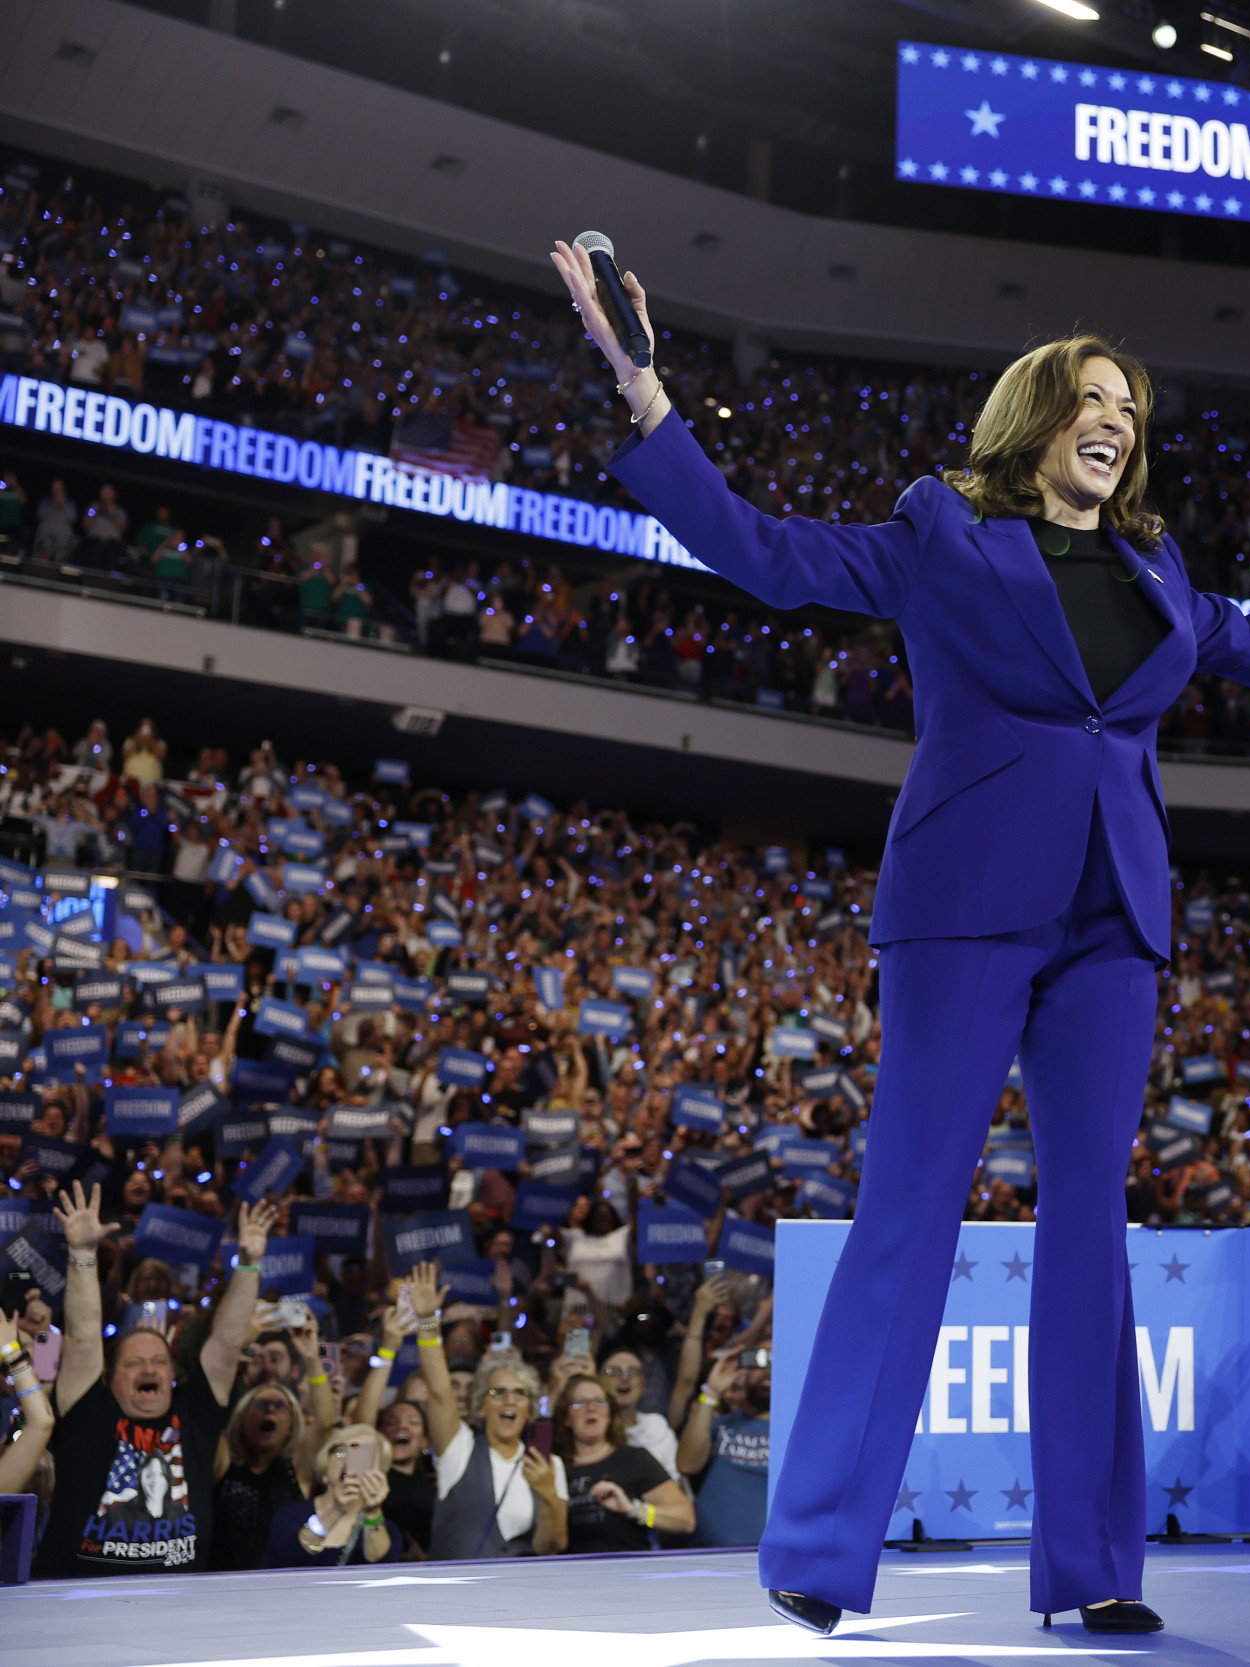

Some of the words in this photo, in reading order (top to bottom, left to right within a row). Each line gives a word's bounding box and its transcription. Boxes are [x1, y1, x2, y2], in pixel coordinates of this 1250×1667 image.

[15, 377, 194, 462] FREEDOM
[194, 417, 356, 495] FREEDOM
[354, 452, 507, 526] FREEDOM
[507, 486, 647, 558] FREEDOM
[76, 982, 120, 999] FREEDOM
[156, 984, 204, 1004] FREEDOM
[53, 1036, 101, 1057] FREEDOM
[113, 1100, 172, 1118] FREEDOM
[333, 1111, 390, 1128] FREEDOM
[223, 1122, 266, 1142] FREEDOM
[528, 1117, 575, 1133] FREEDOM
[465, 1135, 519, 1154] FREEDOM
[145, 1217, 213, 1249] FREEDOM
[298, 1215, 361, 1238] FREEDOM
[648, 1223, 705, 1245] FREEDOM
[395, 1222, 462, 1256] FREEDOM
[7, 1236, 67, 1296] FREEDOM
[83, 1512, 197, 1543] HARRIS
[102, 1534, 197, 1558] PRESIDENT
